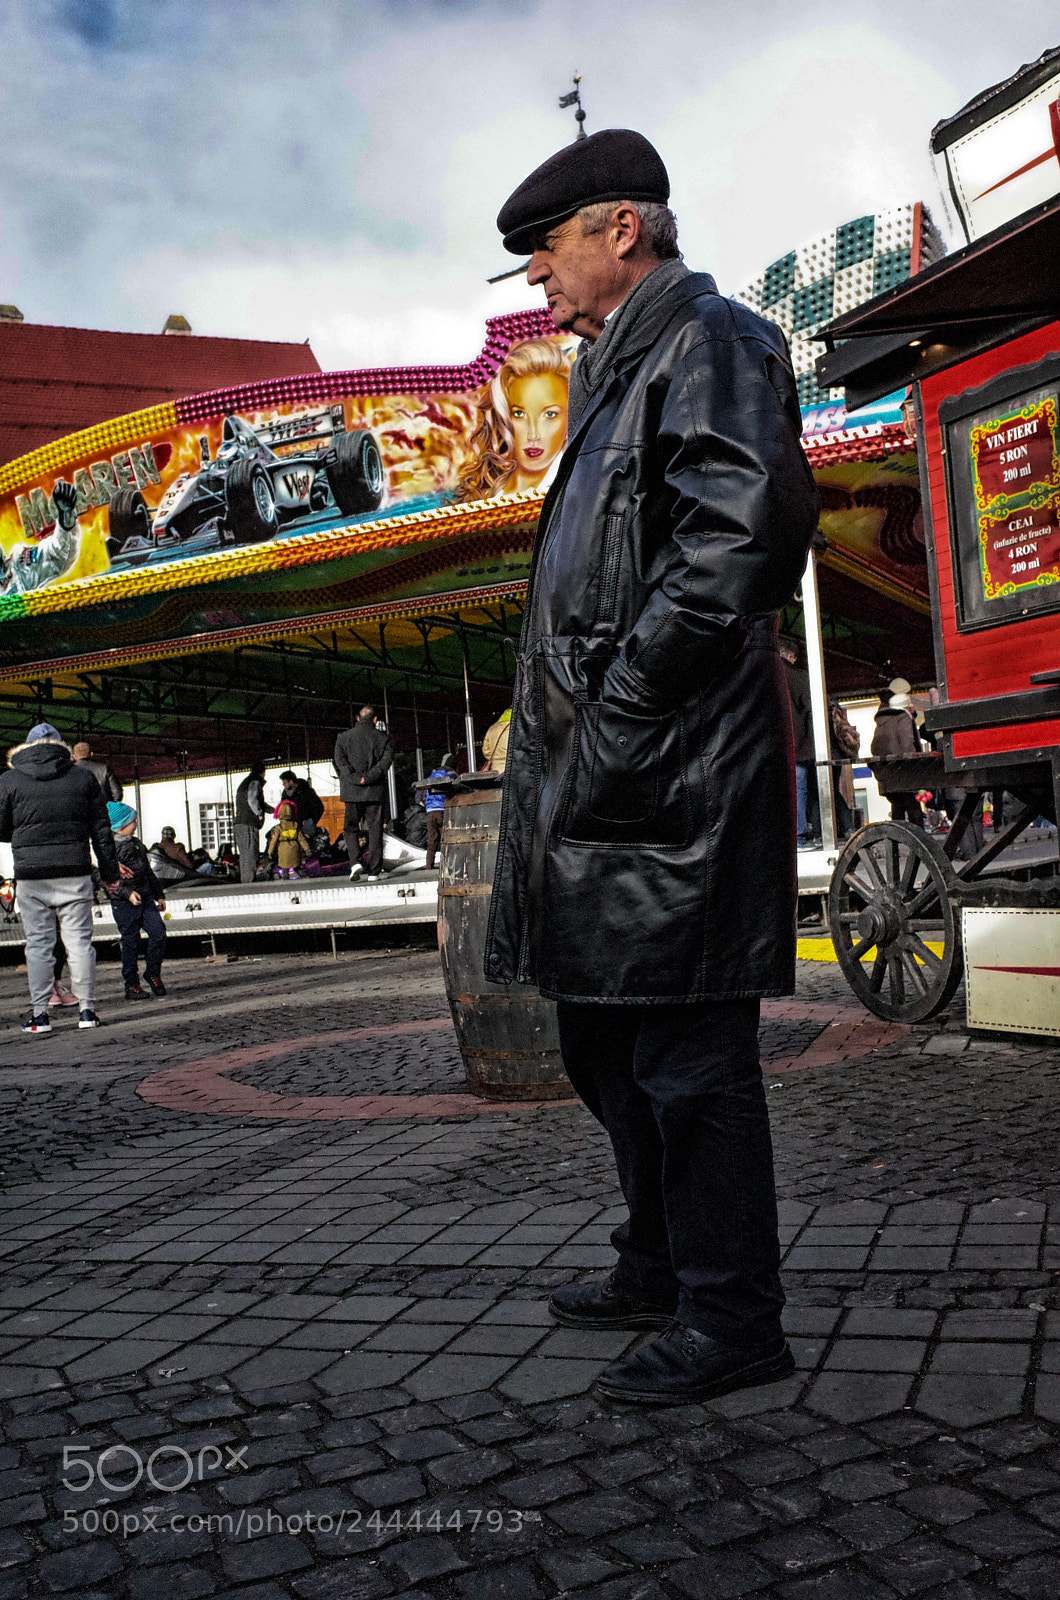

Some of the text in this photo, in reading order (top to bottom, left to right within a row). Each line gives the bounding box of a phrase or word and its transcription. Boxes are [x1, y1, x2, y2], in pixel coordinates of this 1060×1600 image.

[986, 419, 1039, 449] VIN FIERT
[999, 444, 1028, 465] 5 RON
[1002, 462, 1032, 483] 200 ml
[15, 441, 161, 538] MAREN
[1008, 515, 1034, 531] CEAI
[1019, 533, 1028, 542] de
[1028, 524, 1052, 539] fructe)
[1008, 541, 1038, 559] 4 RON
[1011, 557, 1040, 574] 200 ml
